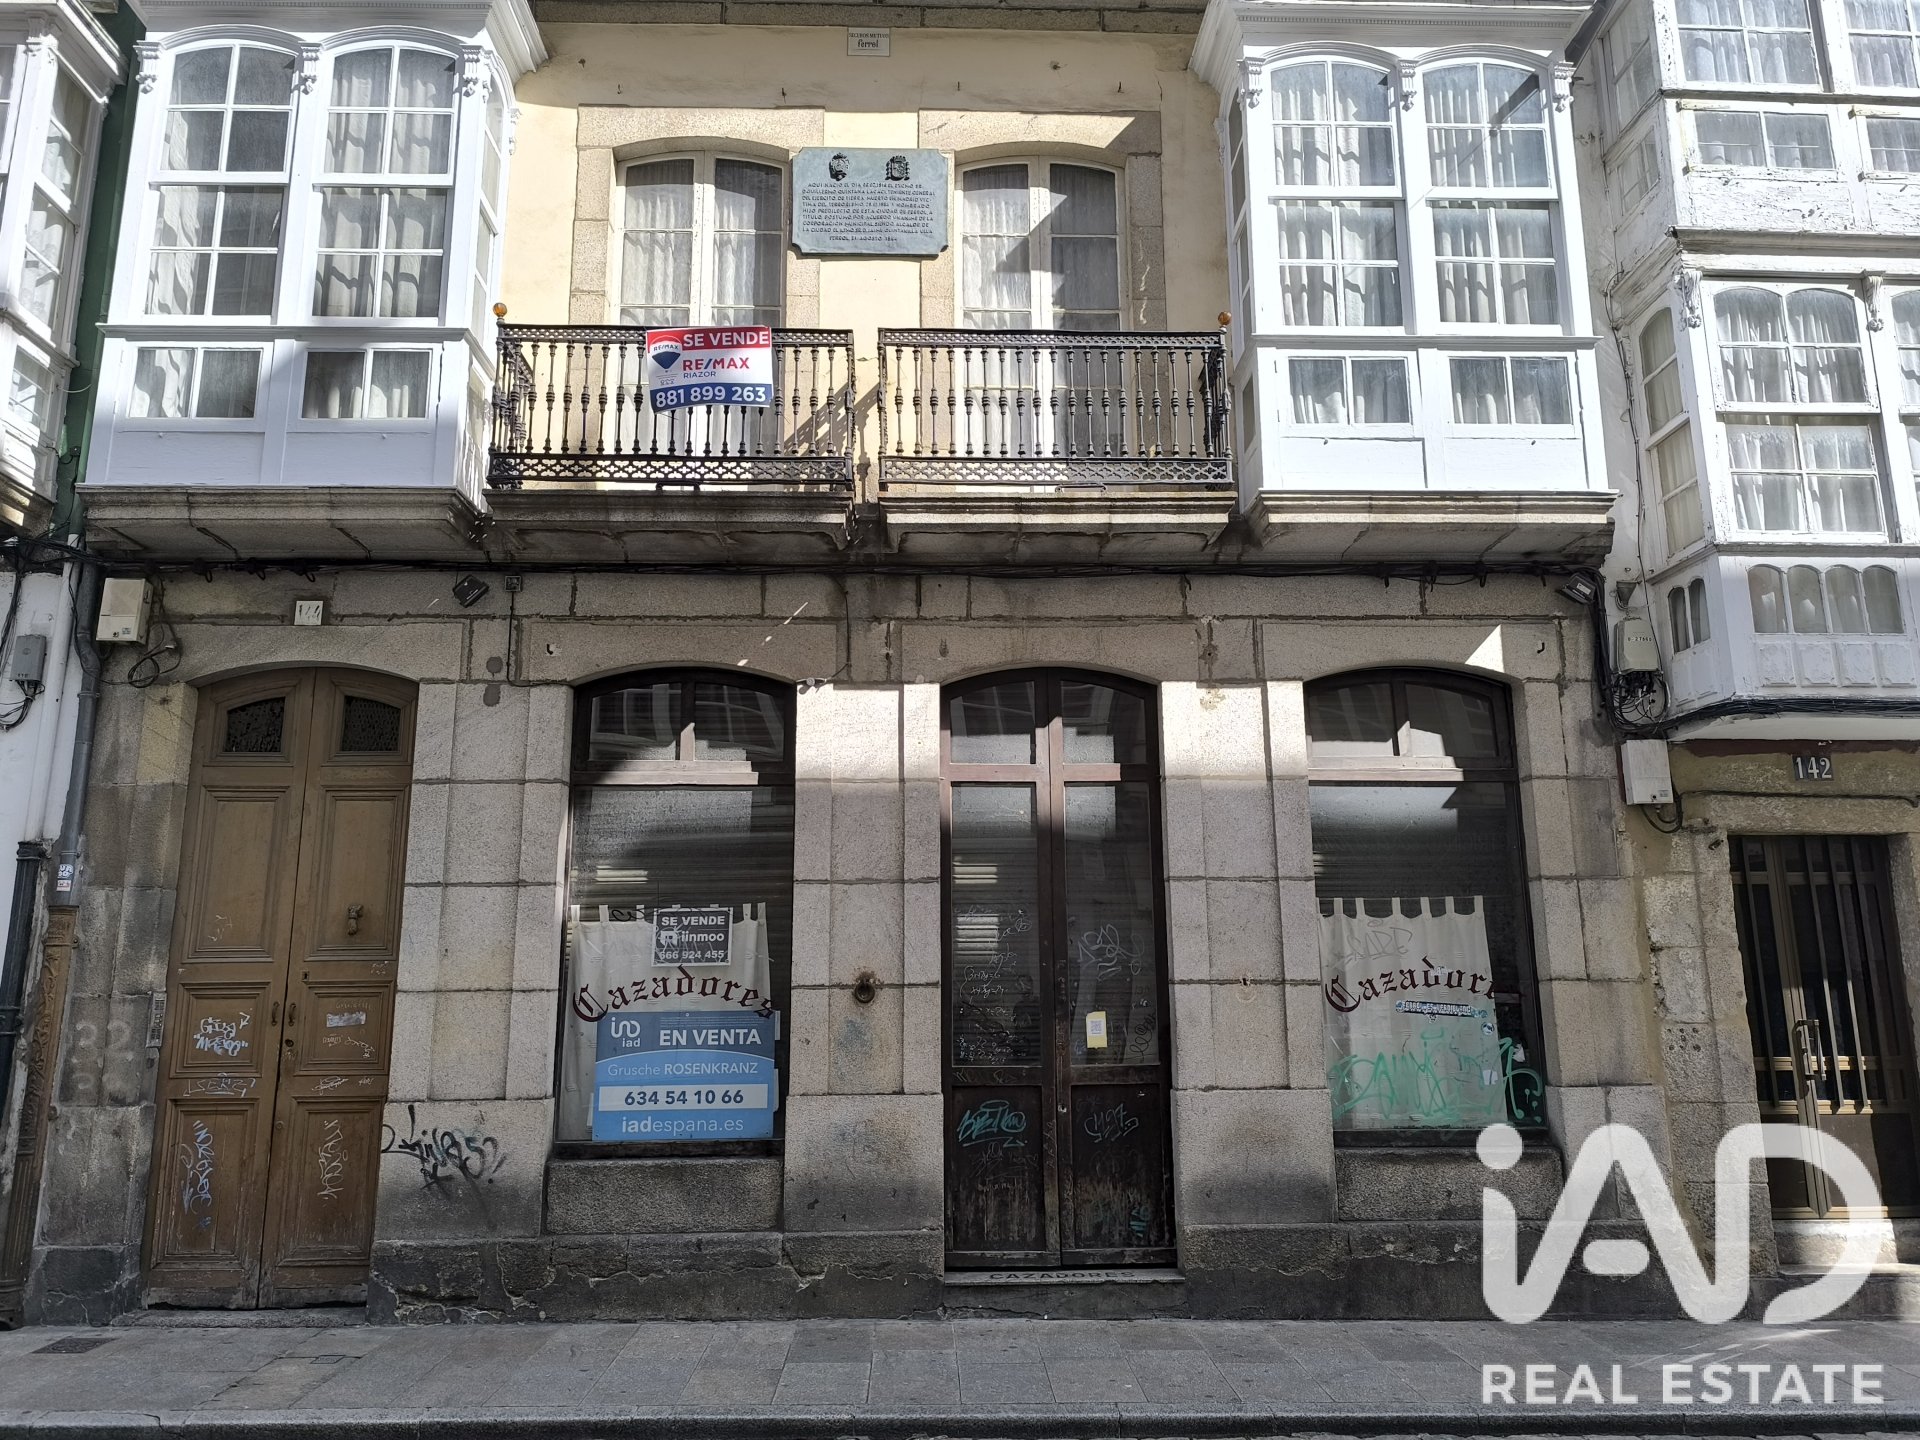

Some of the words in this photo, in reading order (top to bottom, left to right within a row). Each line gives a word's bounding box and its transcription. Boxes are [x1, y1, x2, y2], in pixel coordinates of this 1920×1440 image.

[684, 334, 704, 347] SE
[710, 331, 769, 346] VENDE
[683, 357, 749, 371] RE/MAX
[656, 389, 684, 408] 881
[690, 386, 725, 402] 899
[732, 386, 765, 402] 263
[1796, 757, 1832, 778] 142
[662, 917, 678, 926] SE
[682, 916, 725, 926] VENDE
[660, 951, 678, 959] 666
[682, 951, 701, 959] 924
[704, 950, 724, 958] 455
[573, 964, 776, 1022] Cazadores
[622, 1038, 641, 1048] iad
[659, 1030, 687, 1046] EN
[692, 1028, 762, 1045] VENTA
[608, 1064, 660, 1076] Grusche
[664, 1062, 758, 1075] ROSENKRANZ
[624, 1091, 659, 1105] 634
[665, 1091, 688, 1104] 54
[694, 1090, 716, 1104] 10
[721, 1090, 744, 1104] 66
[622, 1116, 744, 1136] iadespana.es
[990, 1272, 1135, 1280] CAZADORES
